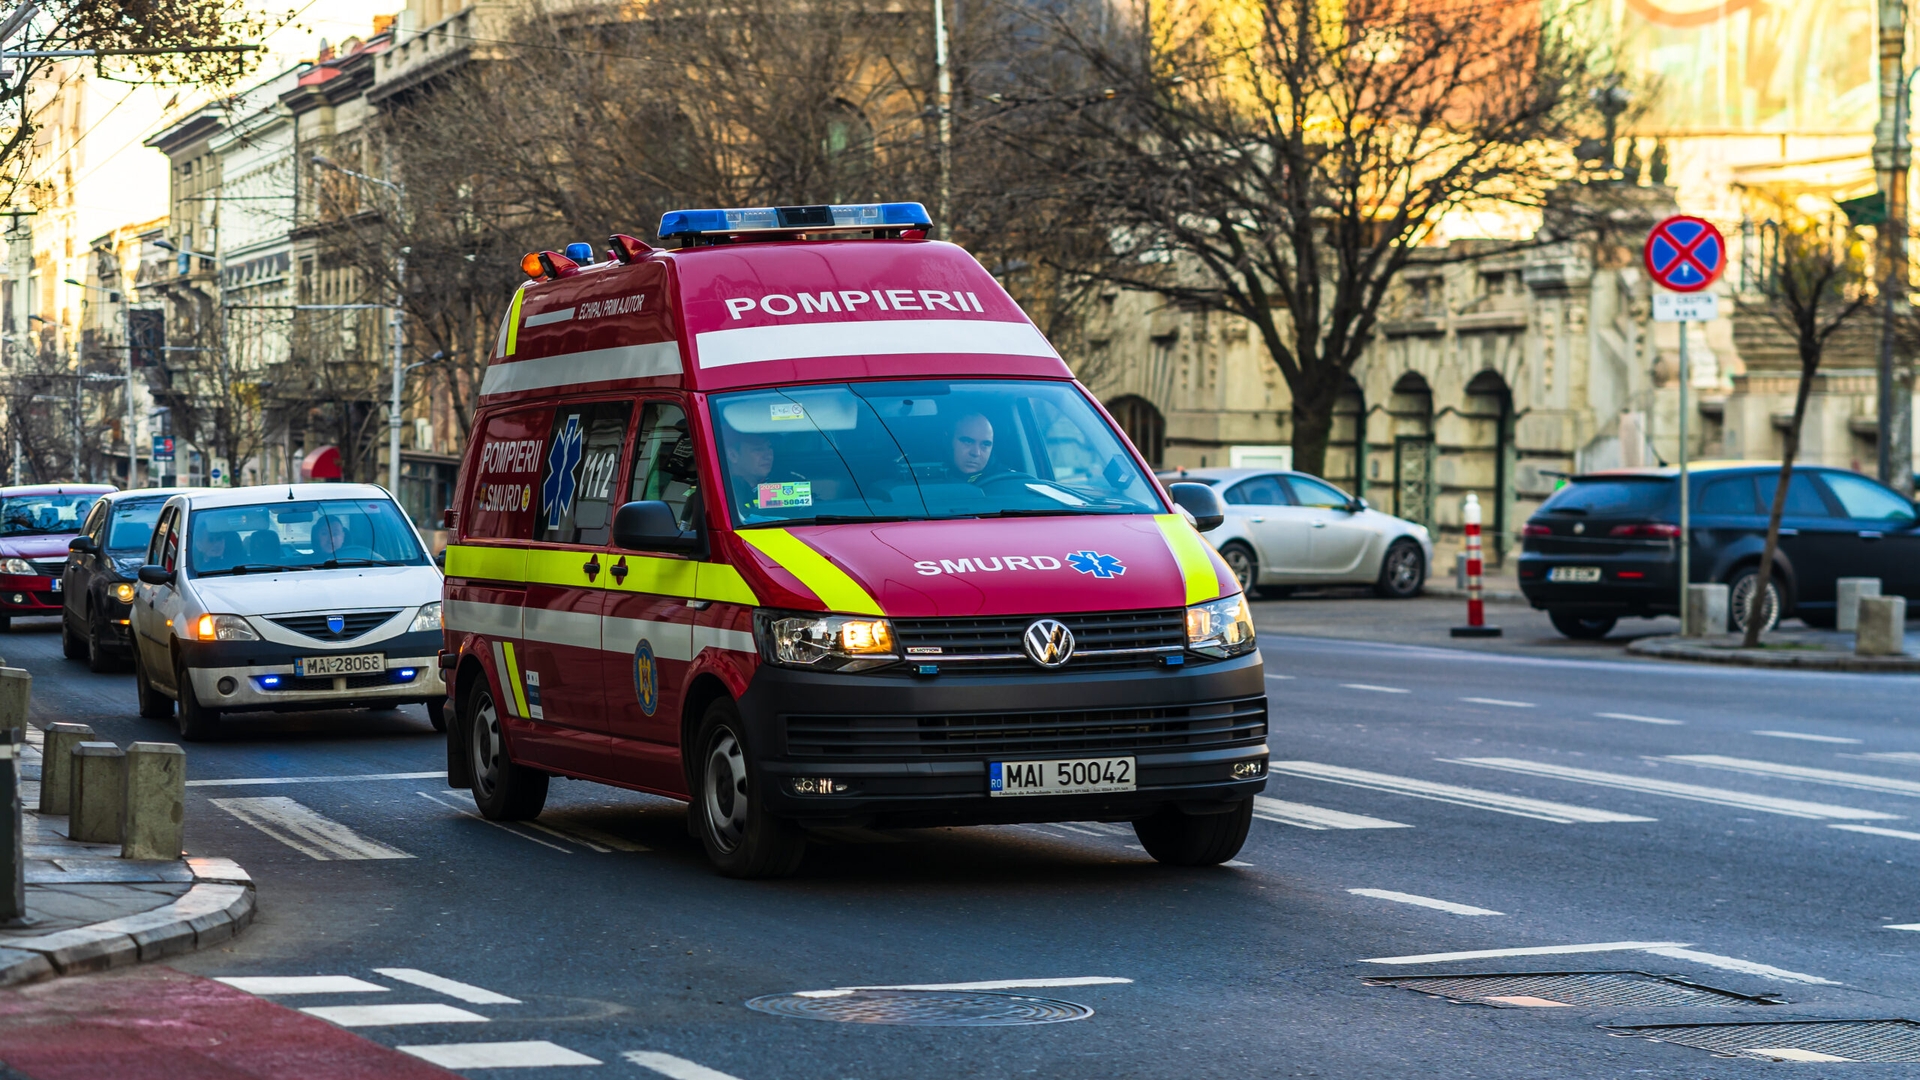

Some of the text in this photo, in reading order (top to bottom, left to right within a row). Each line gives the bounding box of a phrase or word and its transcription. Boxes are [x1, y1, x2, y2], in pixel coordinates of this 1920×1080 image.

[578, 294, 645, 320] ECHIPAJ PRIM AJUTOR
[725, 289, 985, 320] POMPIERII
[481, 439, 543, 474] POMPIERII
[585, 453, 615, 498] 112
[485, 484, 521, 511] SMURD
[913, 555, 1062, 576] SMURD
[307, 655, 380, 674] MAI 28068
[991, 778, 1002, 788] RO
[1006, 760, 1131, 788] MAI 50042
